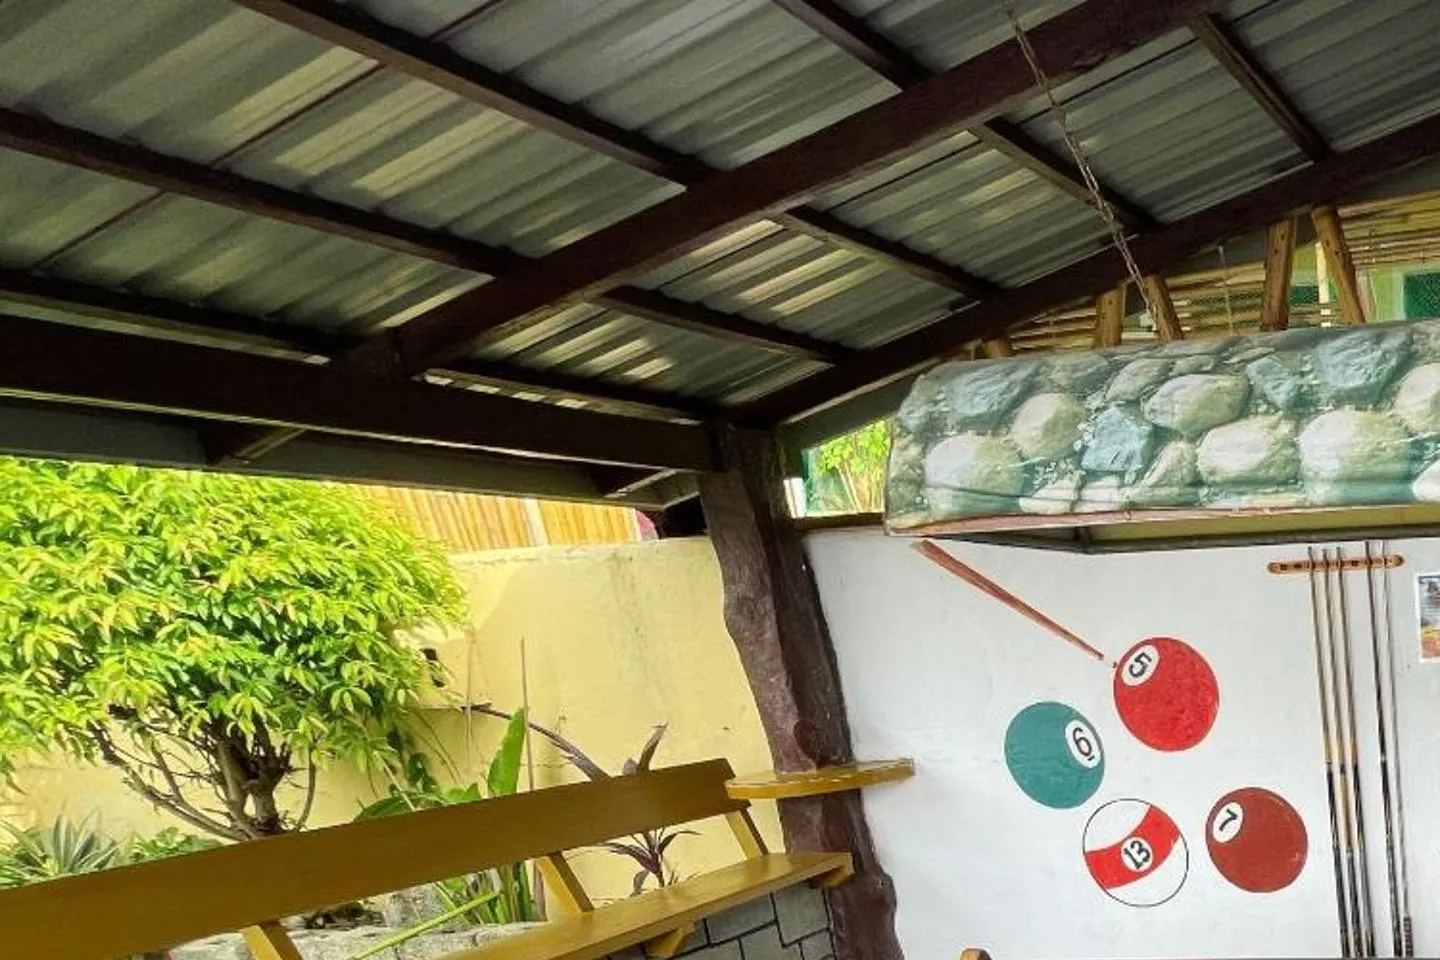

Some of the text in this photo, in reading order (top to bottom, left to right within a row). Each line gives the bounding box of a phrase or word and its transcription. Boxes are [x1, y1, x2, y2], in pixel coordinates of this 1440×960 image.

[1129, 652, 1152, 678] 5
[1072, 727, 1093, 757] 6
[1219, 808, 1238, 831] 7
[1123, 840, 1150, 870] 13
